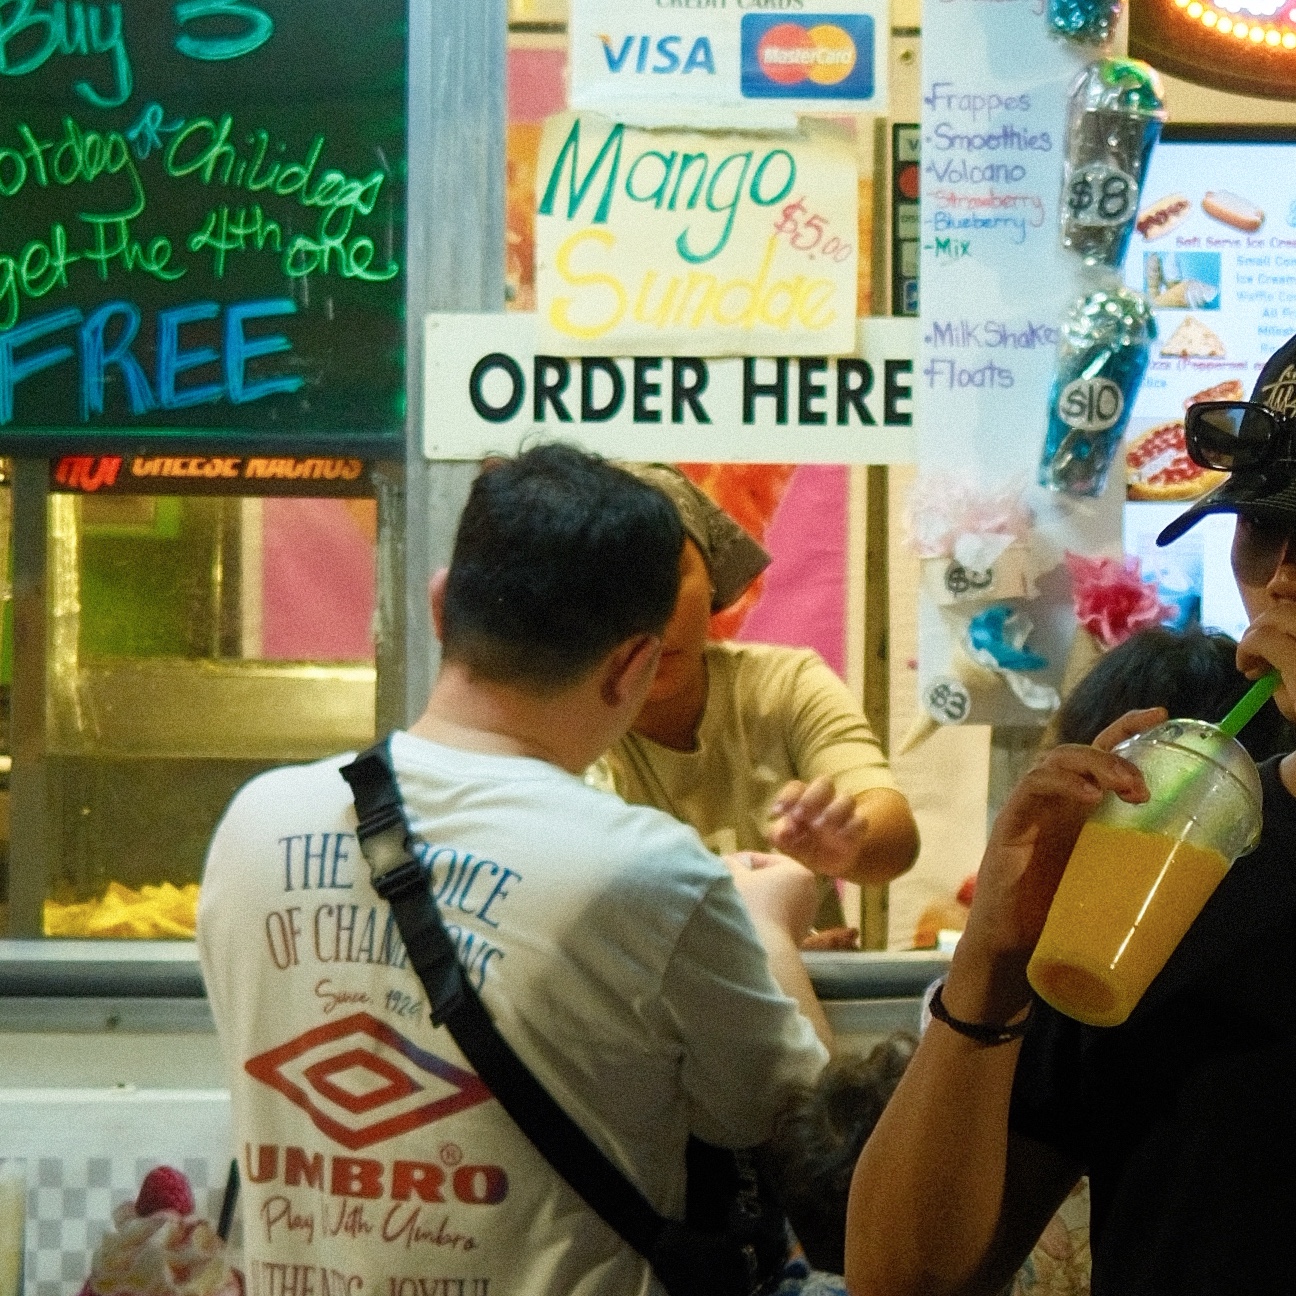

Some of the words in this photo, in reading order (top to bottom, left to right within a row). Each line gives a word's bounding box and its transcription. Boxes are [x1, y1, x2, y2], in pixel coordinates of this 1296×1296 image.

[593, 34, 717, 76] VISA
[0, 115, 146, 222] otdog
[538, 117, 797, 265] Mango
[932, 160, 1027, 184] Volcano
[1068, 175, 1131, 221] $8
[187, 204, 281, 280] 4th
[284, 235, 399, 281] one
[934, 237, 972, 258] Mix
[0, 299, 303, 425] FREE
[469, 352, 714, 425] ORDER
[742, 356, 914, 427] HERE
[929, 357, 1015, 390] Floats
[1061, 384, 1121, 421] $10
[278, 833, 356, 892] THE
[265, 907, 303, 971] OF
[245, 1142, 510, 1206] UMBRO
